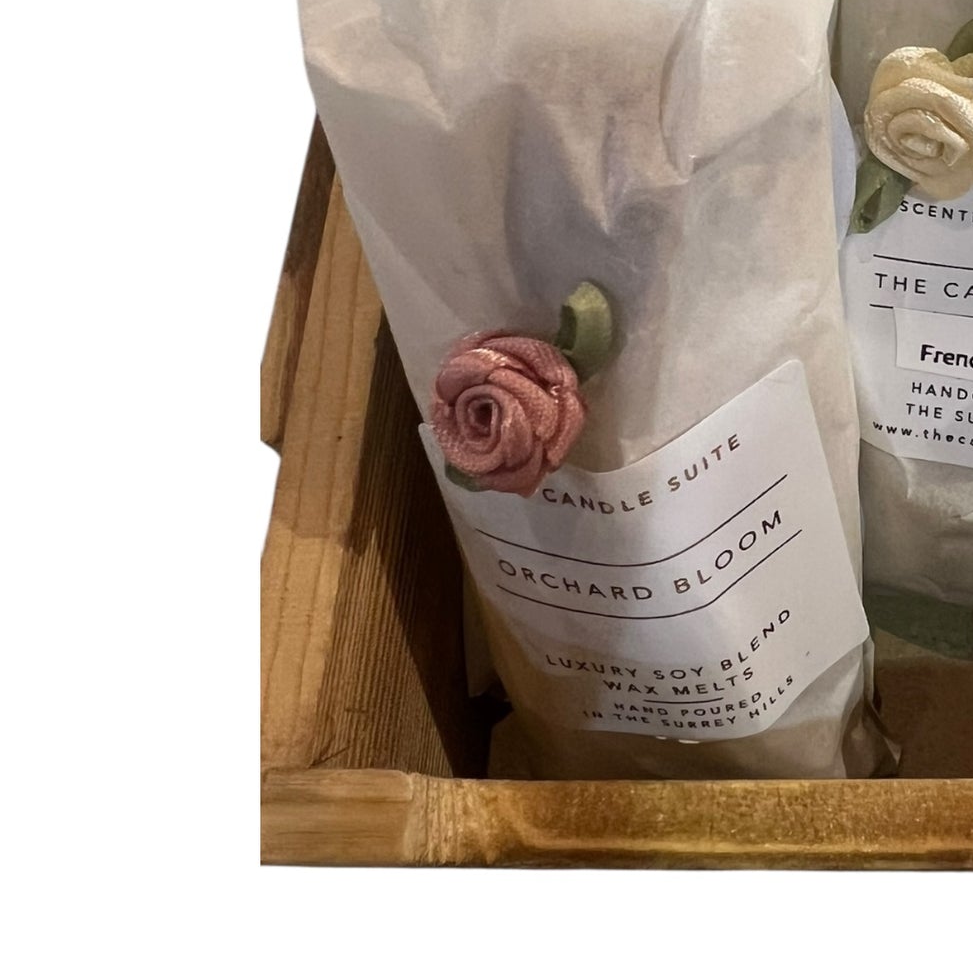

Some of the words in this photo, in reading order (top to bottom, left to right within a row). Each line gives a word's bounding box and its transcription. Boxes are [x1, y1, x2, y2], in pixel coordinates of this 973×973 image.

[874, 272, 927, 294] THE
[906, 403, 943, 420] THE
[542, 487, 654, 515] CANDLE
[667, 433, 741, 492] SUITE
[497, 558, 653, 601] ORCHARD
[673, 509, 782, 594] BLOOM
[546, 653, 637, 679] LUXURY
[653, 664, 704, 681] SOY
[721, 608, 791, 673] BLEND
[583, 710, 604, 719] IN
[613, 713, 650, 724] THE
[661, 716, 736, 729] SURREY
[749, 675, 794, 719] HILLS
[604, 680, 660, 696] WAX
[671, 667, 755, 696] MELTS
[614, 703, 668, 716] HAND
[681, 691, 762, 716] POURED
